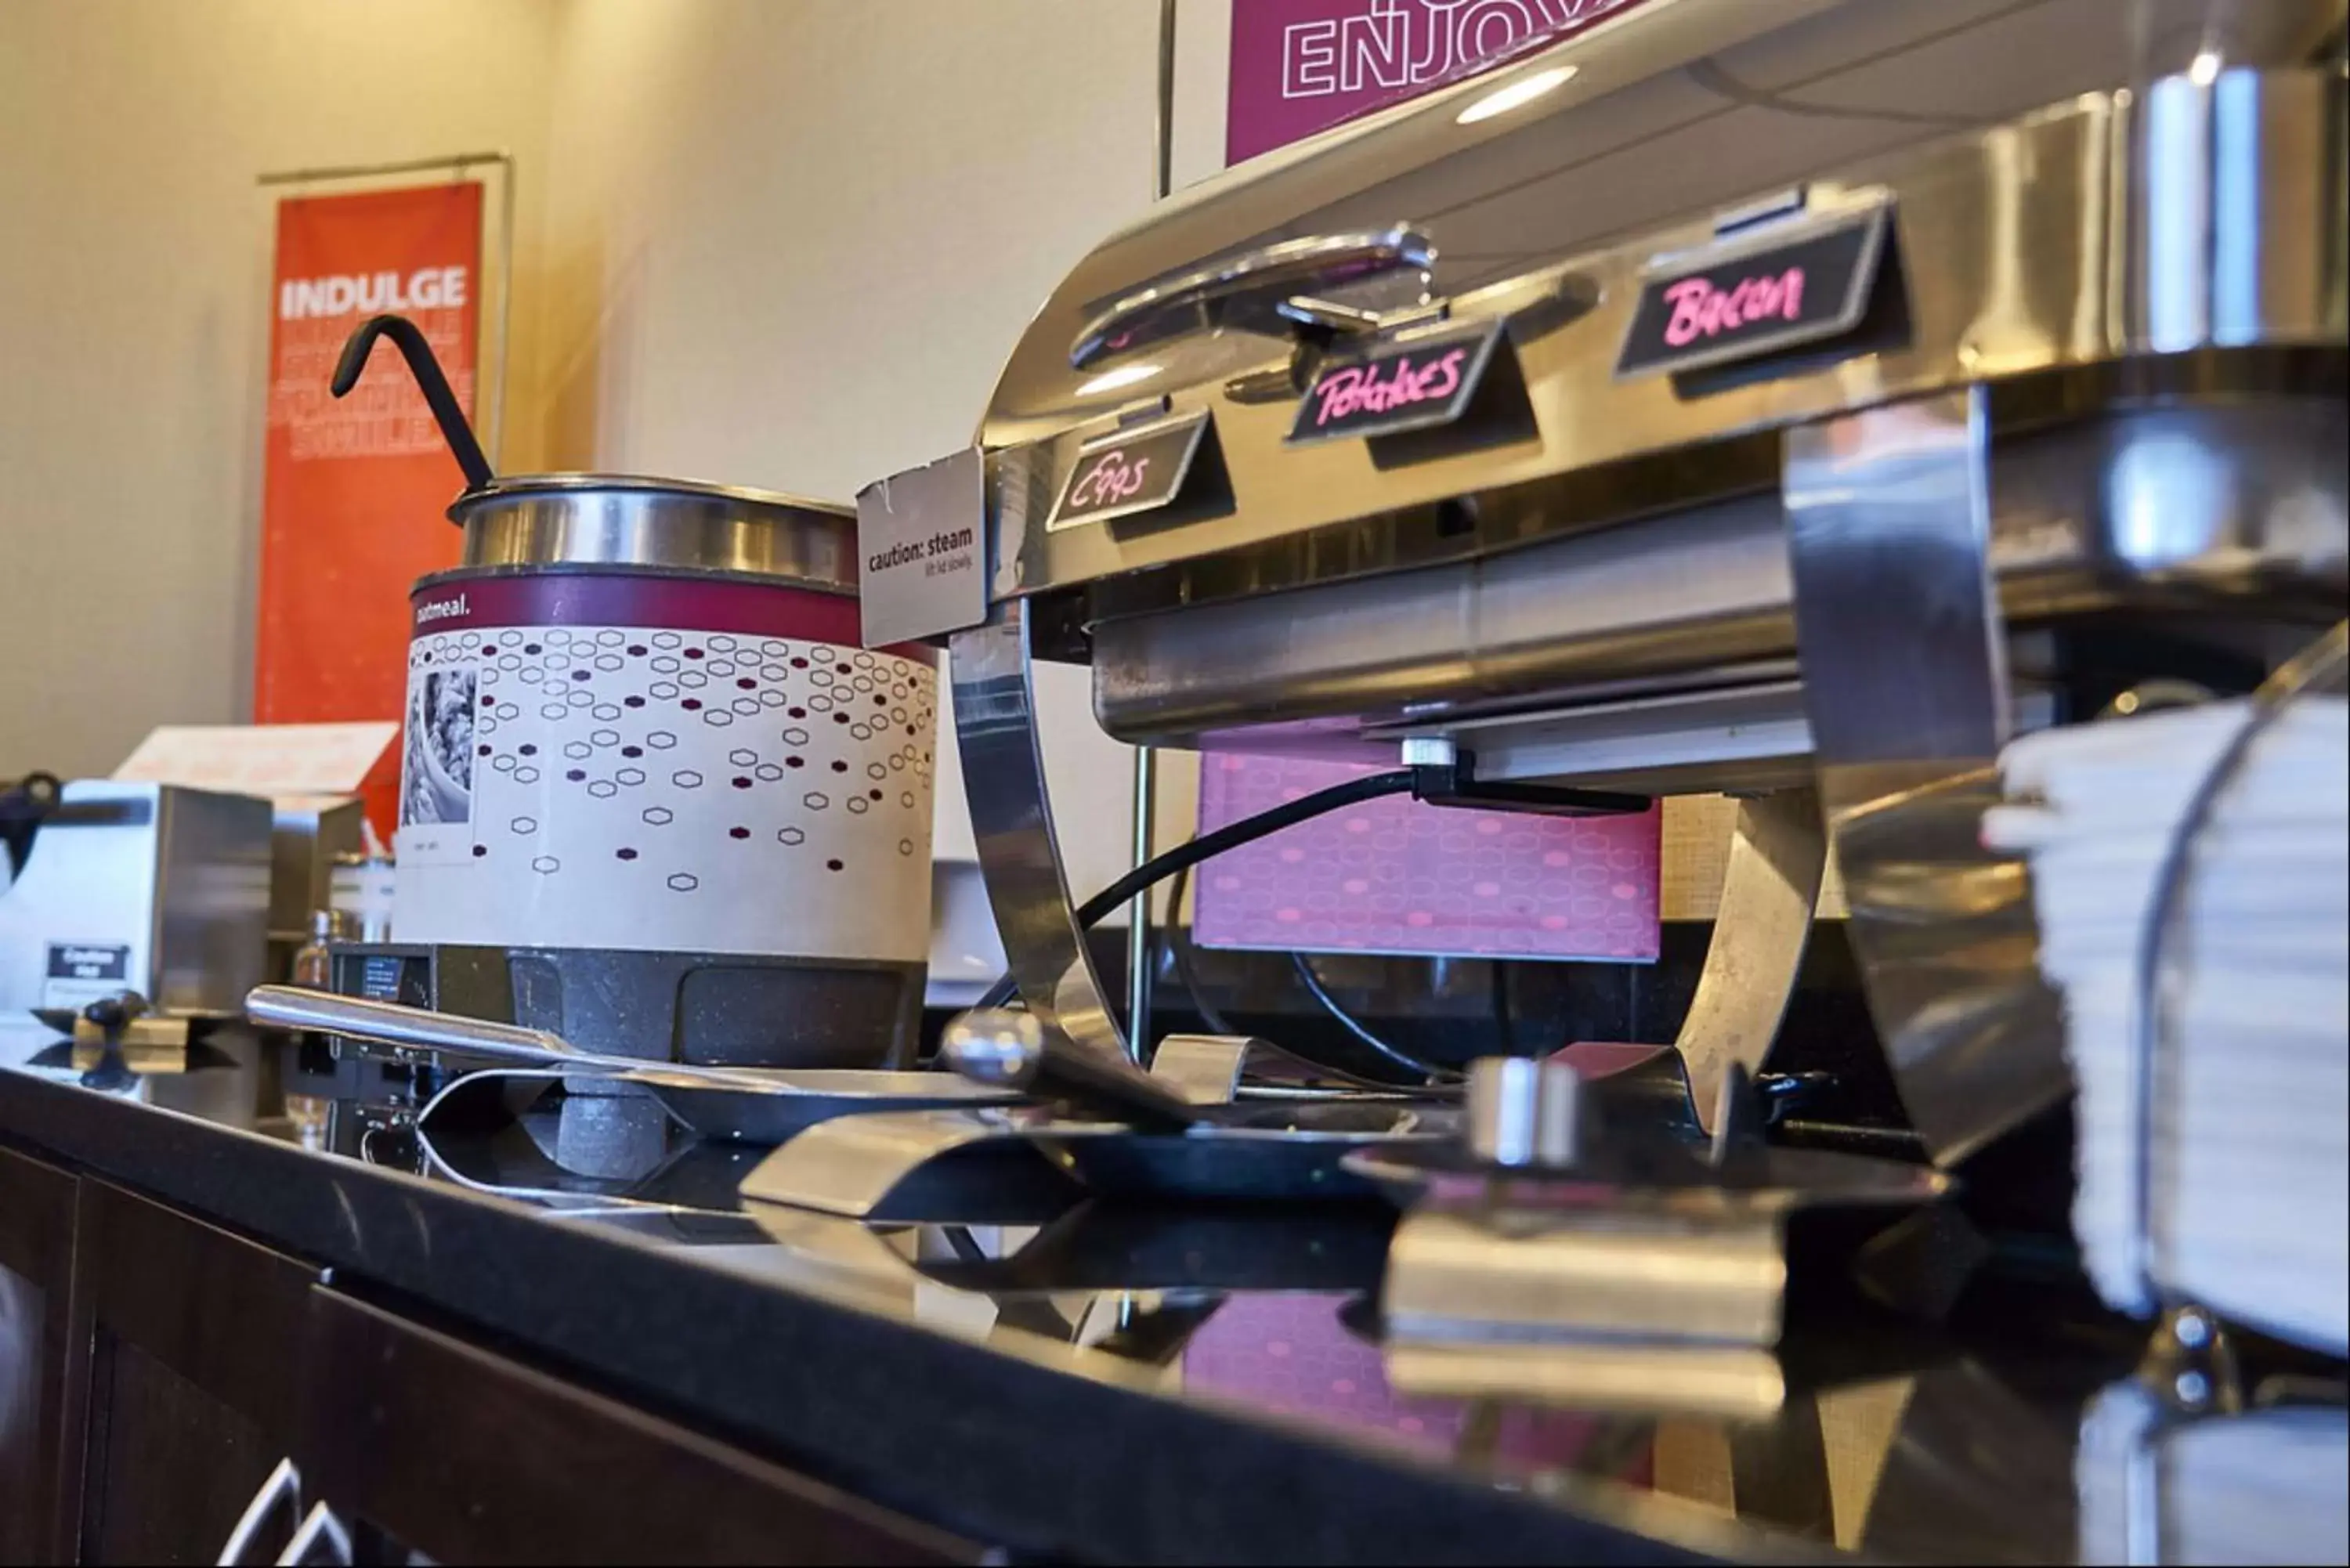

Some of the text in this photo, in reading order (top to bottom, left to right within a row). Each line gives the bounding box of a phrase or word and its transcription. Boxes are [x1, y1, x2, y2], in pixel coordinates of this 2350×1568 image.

[280, 267, 467, 318] INDULGE
[1662, 266, 1805, 346] Bacon
[1070, 450, 1150, 507] Eggs
[869, 527, 972, 573] caution: steam
[417, 592, 471, 623] oatmeal.
